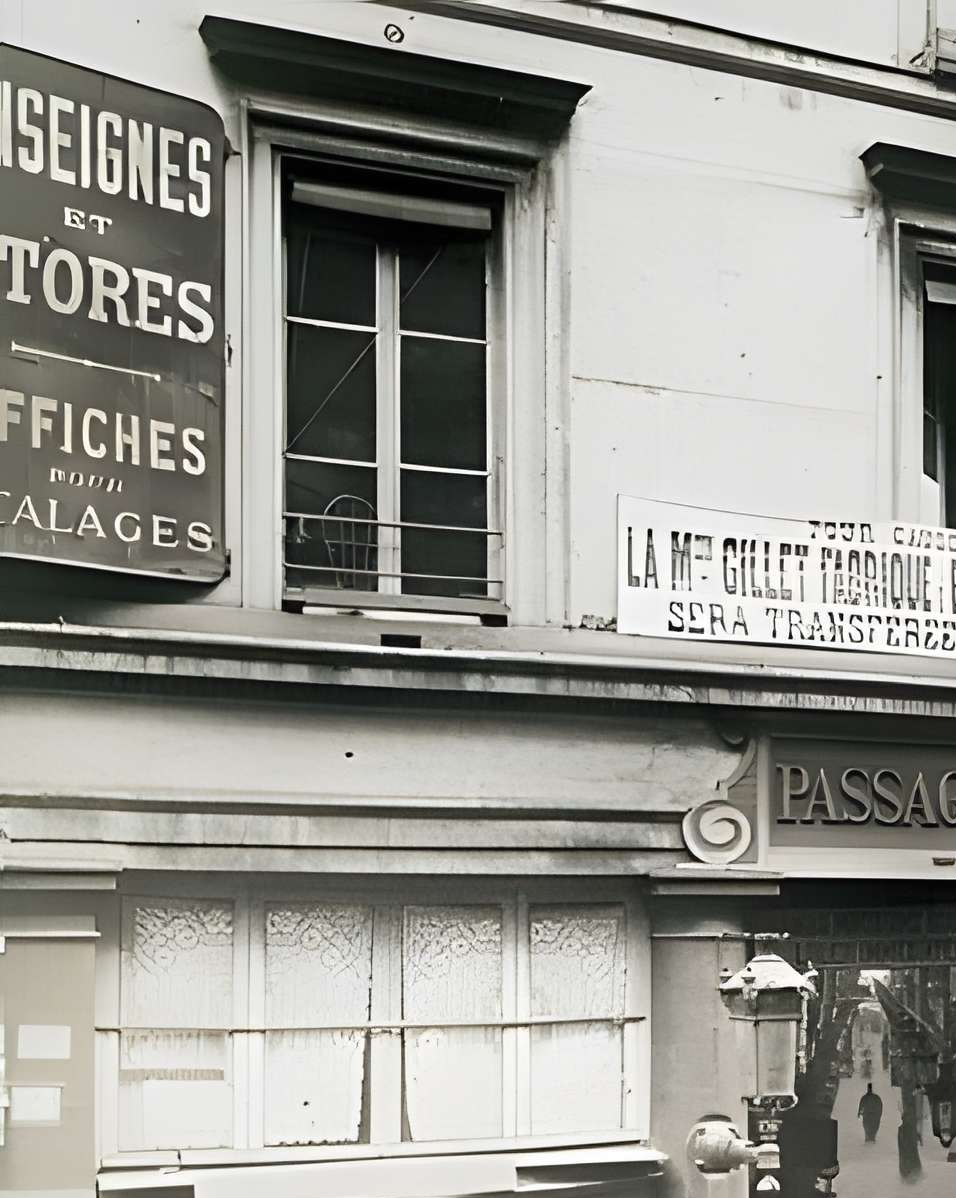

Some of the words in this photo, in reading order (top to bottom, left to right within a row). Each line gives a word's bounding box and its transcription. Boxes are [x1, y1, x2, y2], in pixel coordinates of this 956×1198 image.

[63, 206, 113, 235] ET
[0, 234, 214, 344] TORES
[627, 526, 659, 589] LA
[668, 601, 749, 636] SERA
